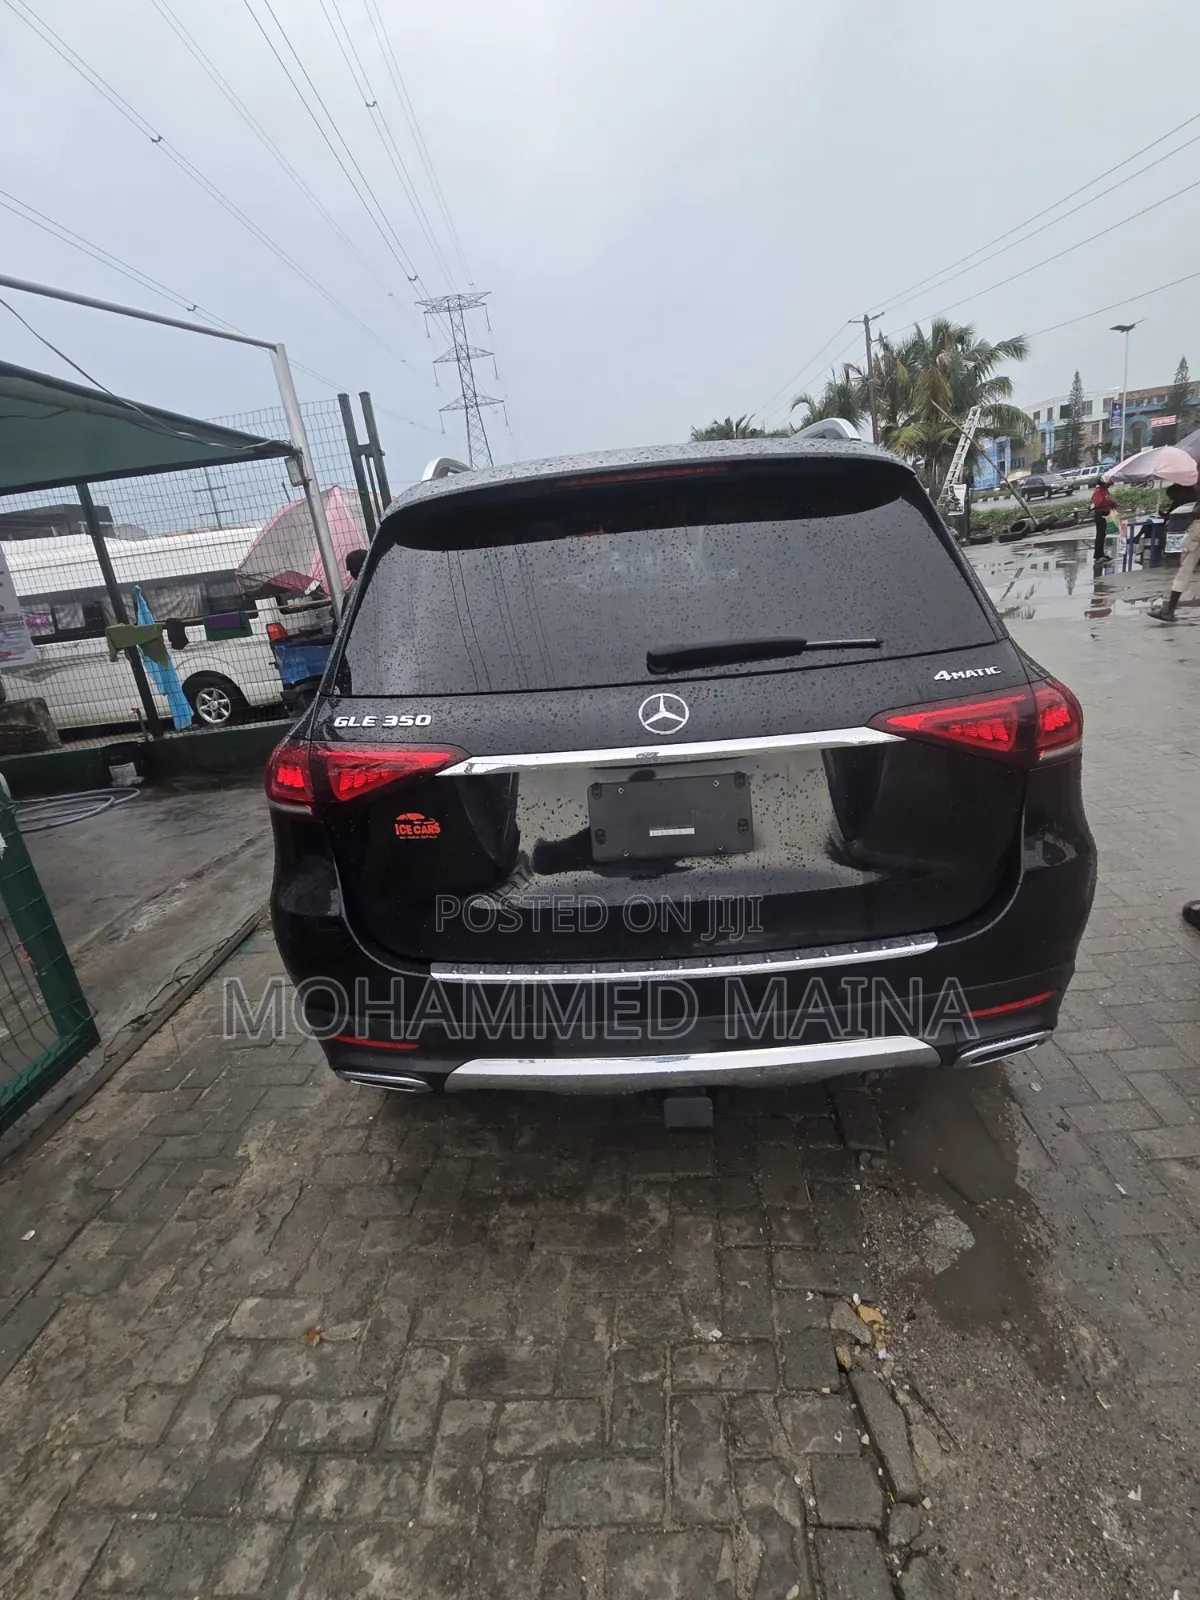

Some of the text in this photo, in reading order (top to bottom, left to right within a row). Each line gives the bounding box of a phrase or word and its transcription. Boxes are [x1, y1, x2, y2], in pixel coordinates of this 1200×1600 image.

[933, 665, 1002, 681] 4MATIC
[333, 714, 432, 727] GLE 350
[394, 822, 441, 836] ICE CARS
